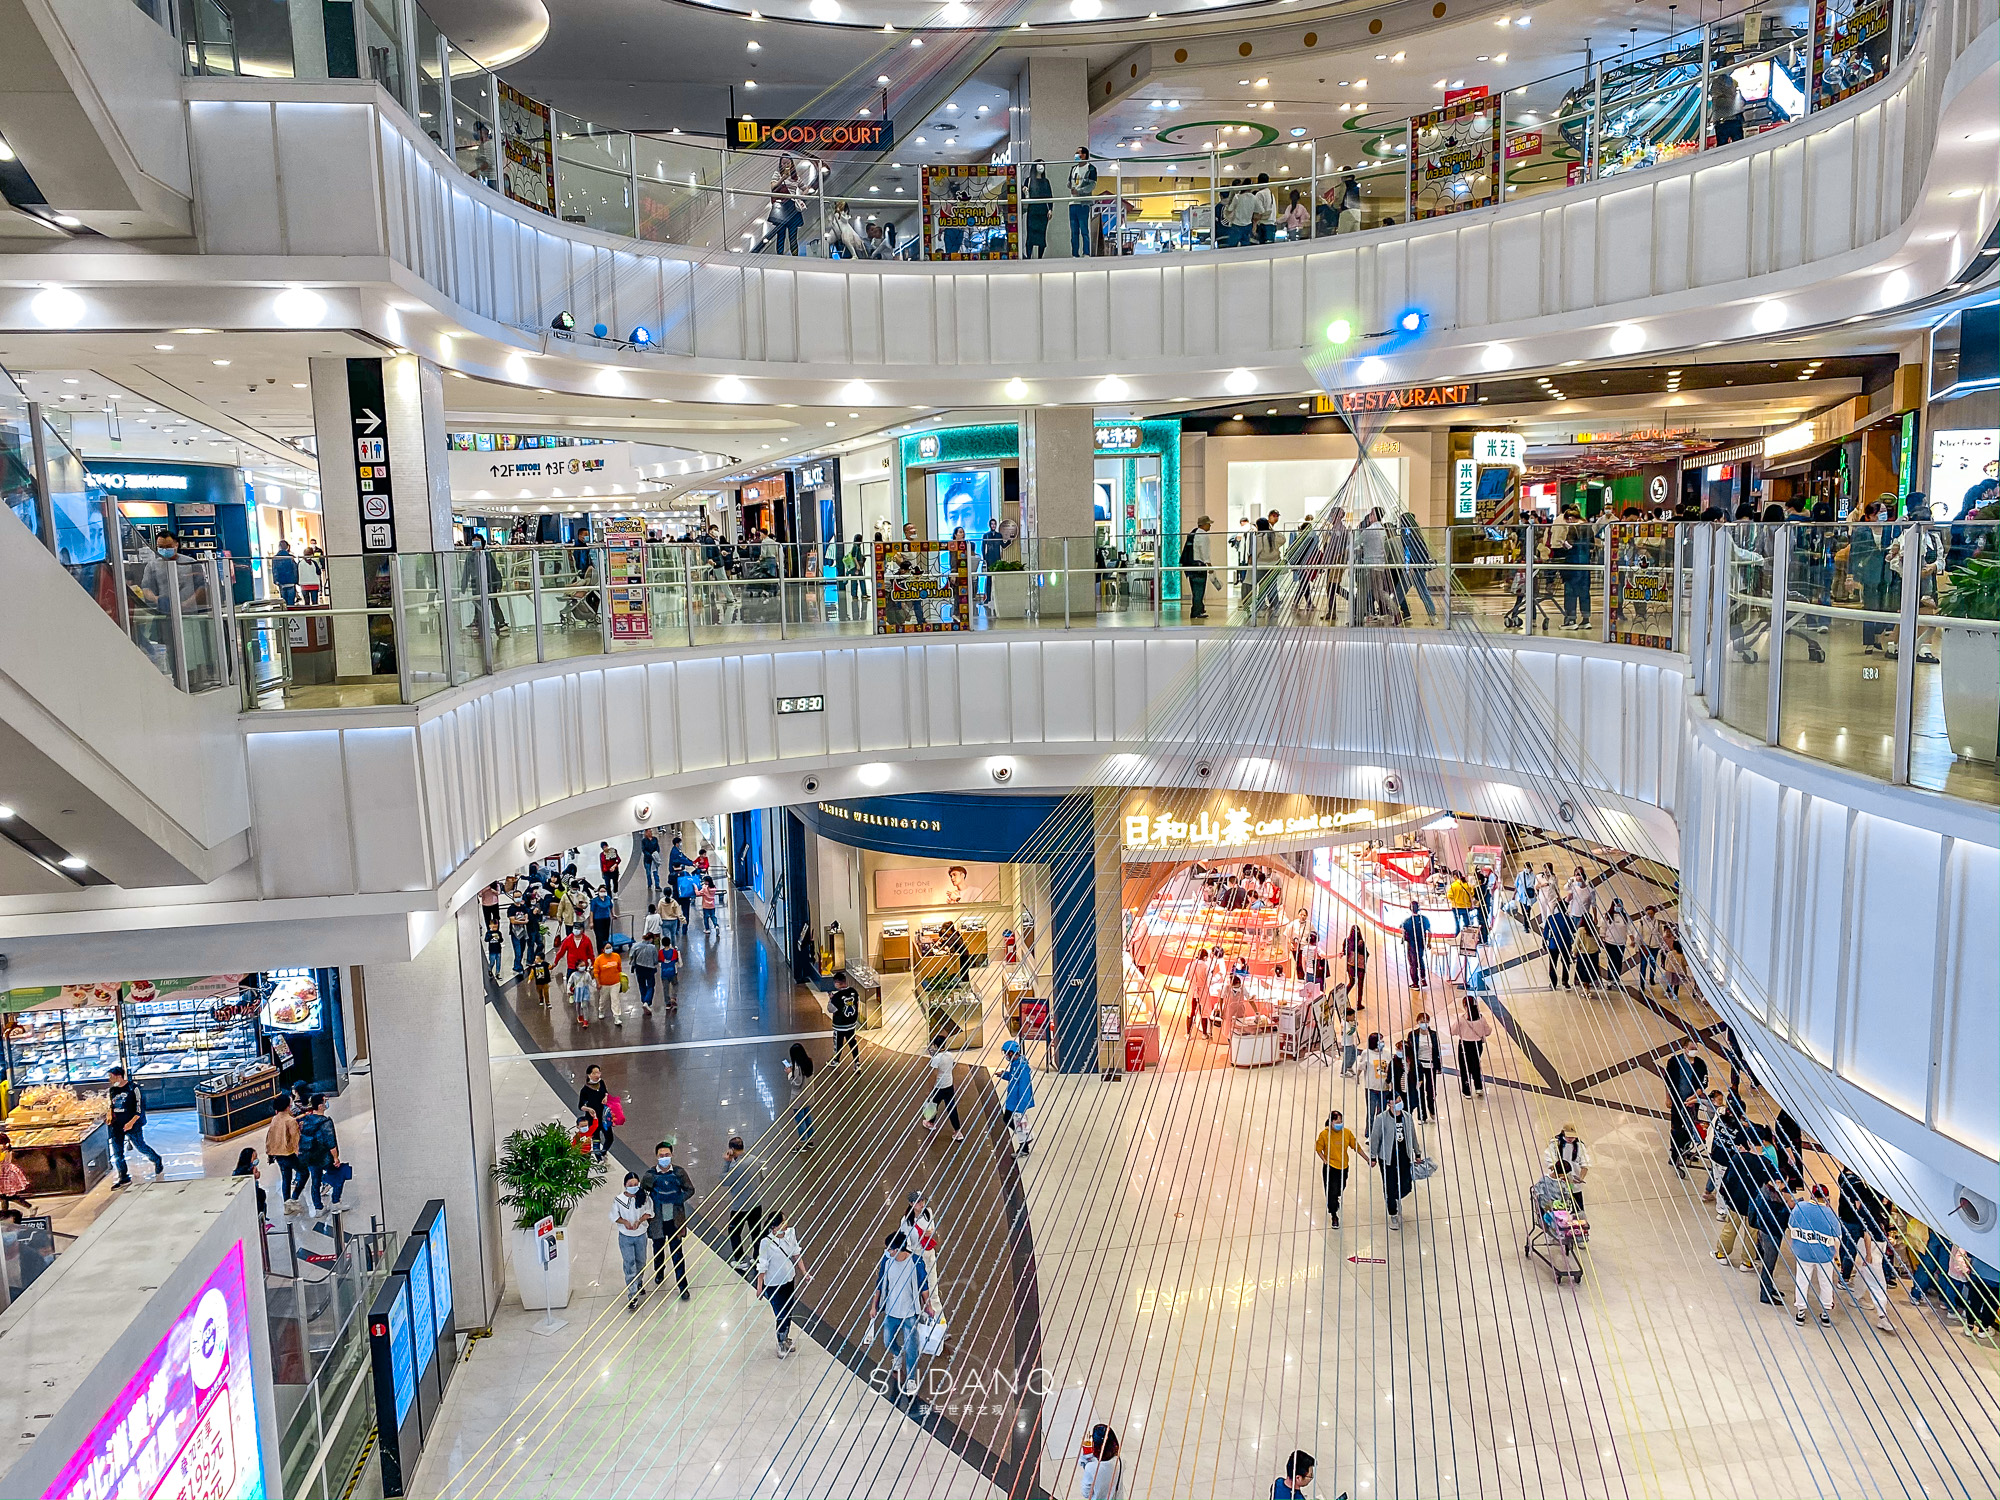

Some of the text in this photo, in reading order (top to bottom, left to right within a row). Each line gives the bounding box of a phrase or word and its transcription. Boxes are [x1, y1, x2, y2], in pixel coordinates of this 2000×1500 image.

[761, 126, 881, 143] FOOD COURT
[1343, 385, 1469, 411] RESTAURANT
[500, 464, 514, 477] 2F
[552, 462, 564, 475] 3F
[1460, 463, 1473, 513] 米芝莲
[818, 801, 941, 832] DANIEL WELLINGTON
[1126, 806, 1254, 846] 日和山茶
